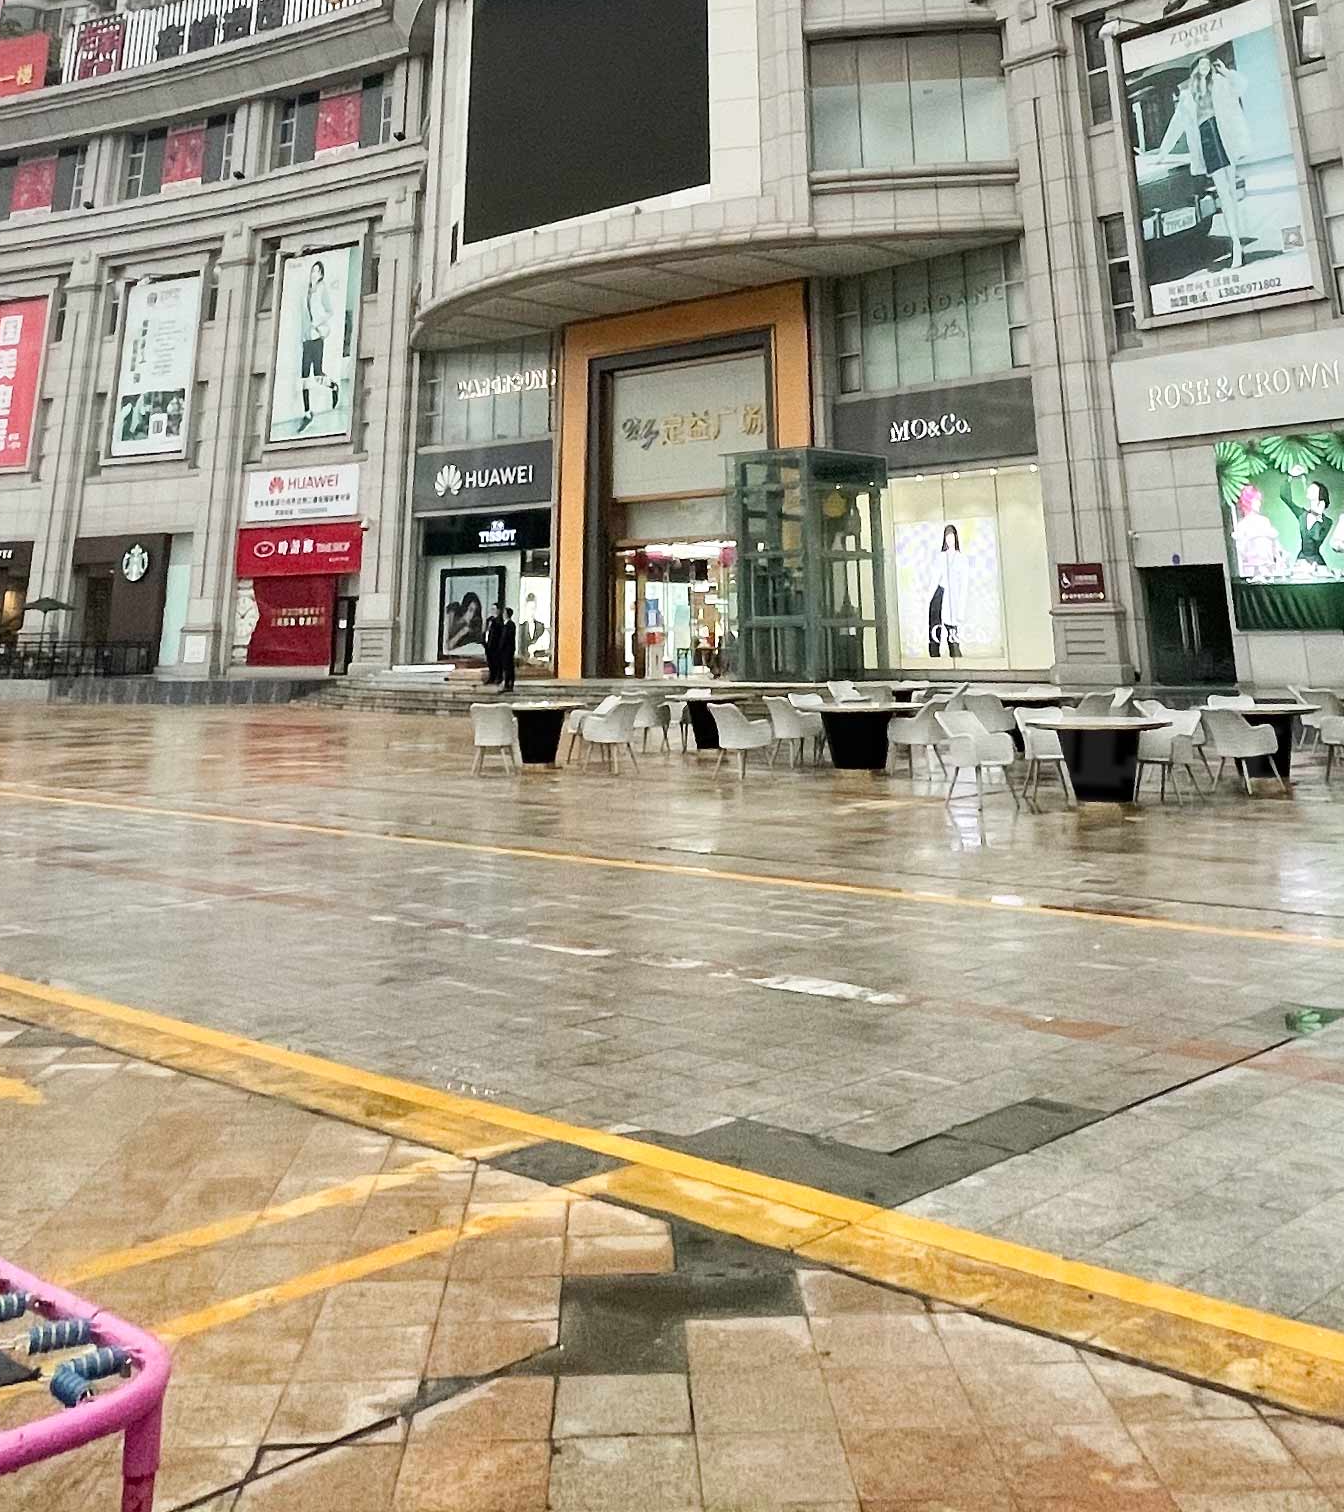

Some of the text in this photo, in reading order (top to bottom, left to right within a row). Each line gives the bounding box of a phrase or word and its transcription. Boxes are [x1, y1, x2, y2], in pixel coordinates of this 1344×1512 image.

[1147, 359, 1340, 412] ROSE & CROWN
[288, 474, 339, 490] HUAWEI
[464, 464, 534, 489] HUAWEI
